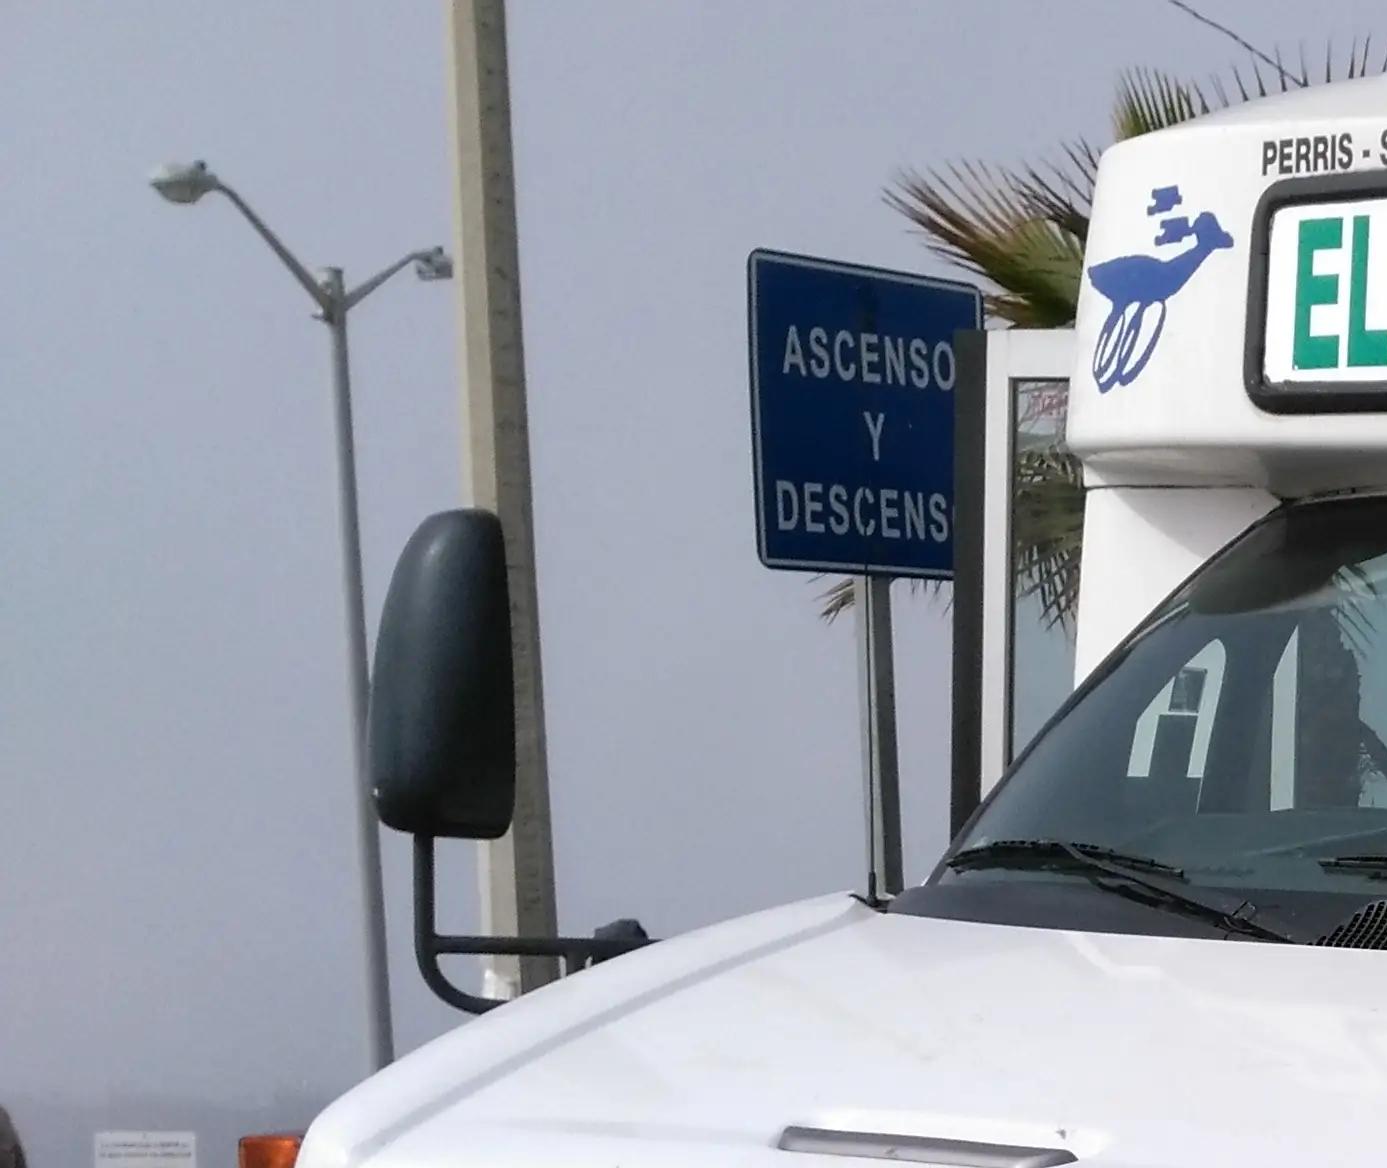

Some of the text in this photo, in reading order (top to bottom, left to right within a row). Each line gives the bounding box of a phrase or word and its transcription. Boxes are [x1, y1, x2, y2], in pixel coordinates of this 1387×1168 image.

[1263, 132, 1353, 176] PERRIS
[782, 325, 955, 391] ASCENSO
[863, 411, 885, 462] Y
[775, 479, 955, 543] DESCENS
